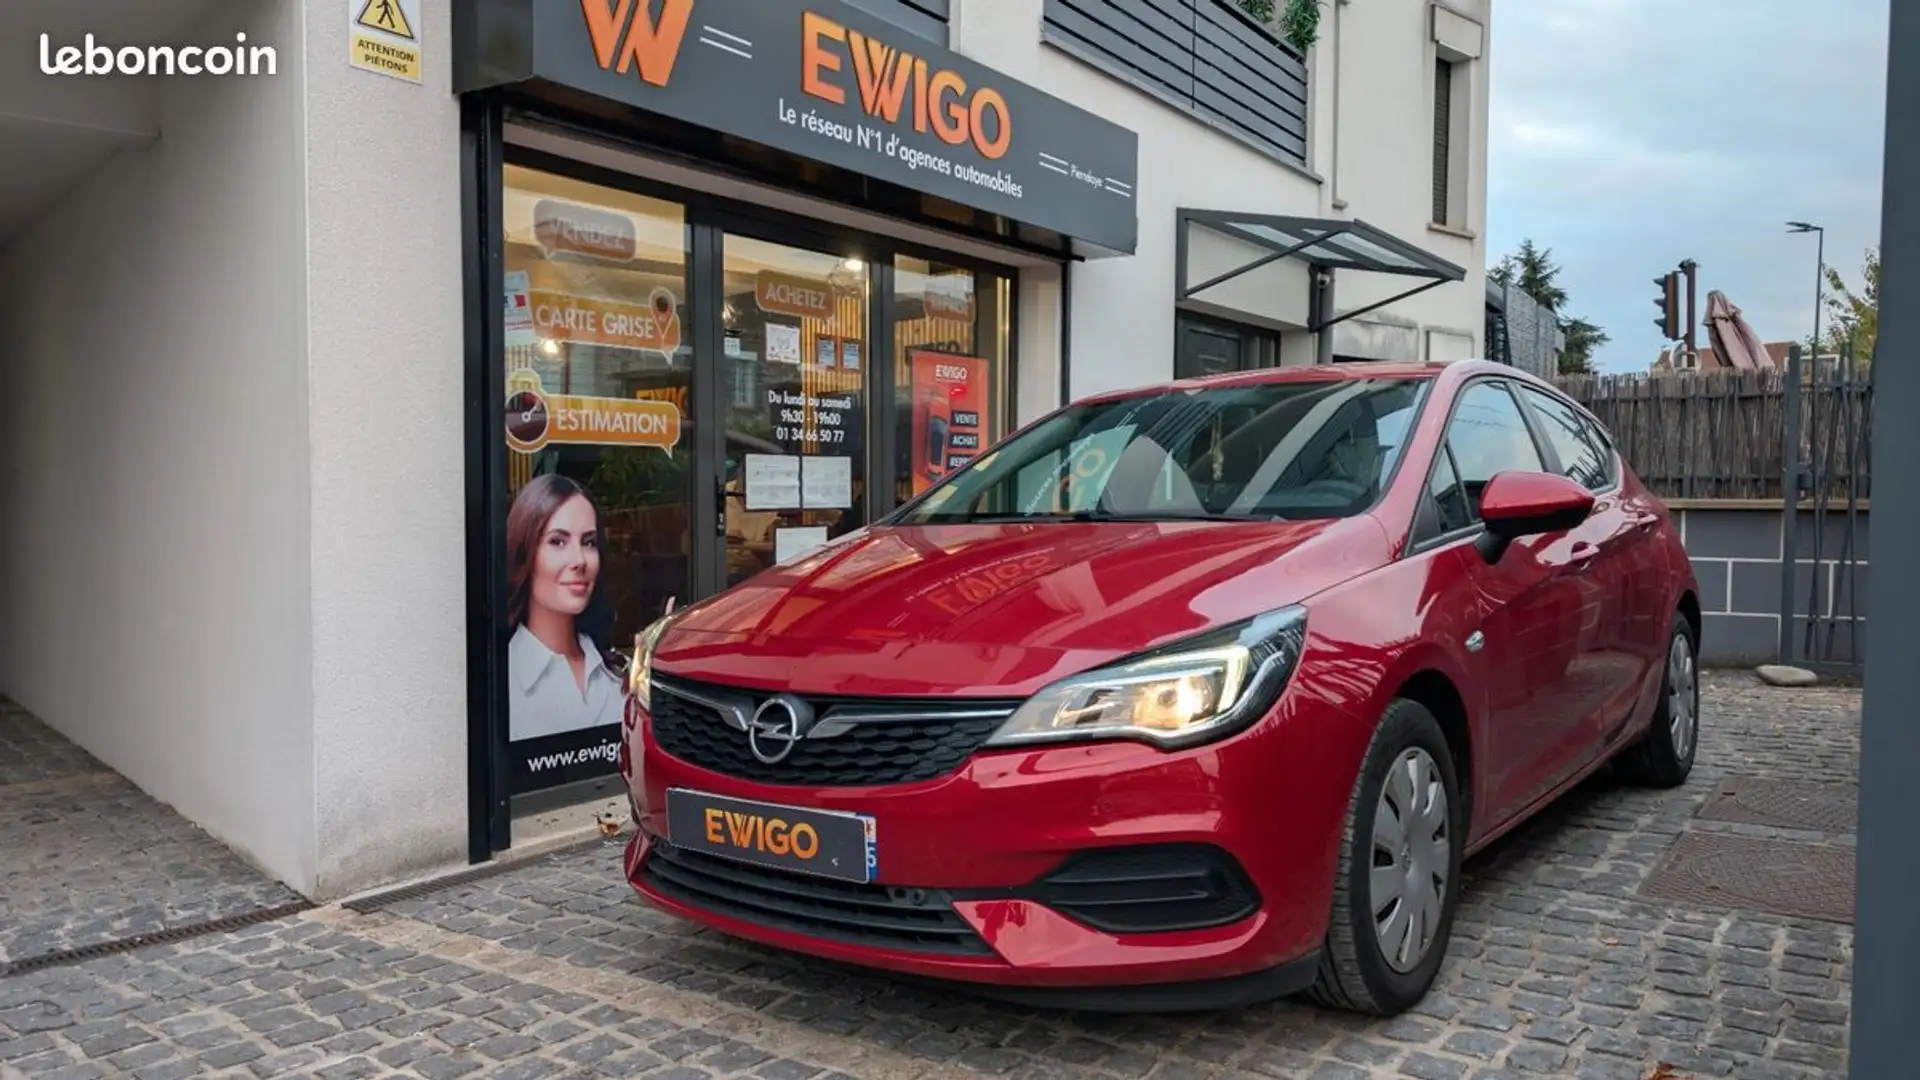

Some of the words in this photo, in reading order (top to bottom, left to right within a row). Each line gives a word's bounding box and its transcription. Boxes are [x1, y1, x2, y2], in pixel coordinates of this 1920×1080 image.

[357, 39, 415, 62] ATTENTION
[364, 53, 408, 73] PIÉTONS
[802, 10, 1012, 160] EWIGO
[778, 98, 797, 125] Le
[801, 109, 853, 143] réseau
[857, 124, 882, 153] N°1
[885, 133, 951, 176] d'agences
[954, 164, 1023, 199] automobiles
[765, 282, 827, 310] ACHETEZ
[535, 304, 596, 332] CARTE
[602, 312, 654, 338] GRISE
[936, 364, 967, 380] EWIGO
[768, 389, 782, 404] Du
[783, 390, 805, 406] lundi
[821, 396, 851, 409] samedi
[556, 407, 668, 435] ESTIMATION
[781, 408, 805, 424] 9h30
[813, 411, 841, 426] 19h00
[955, 413, 977, 425] VENTE
[775, 427, 789, 441] 01
[791, 428, 804, 442] 34
[806, 428, 818, 442] 66
[820, 429, 832, 443] 50
[833, 430, 845, 443] 77
[952, 435, 977, 446] ACHAT
[704, 807, 819, 860] EWIGO
